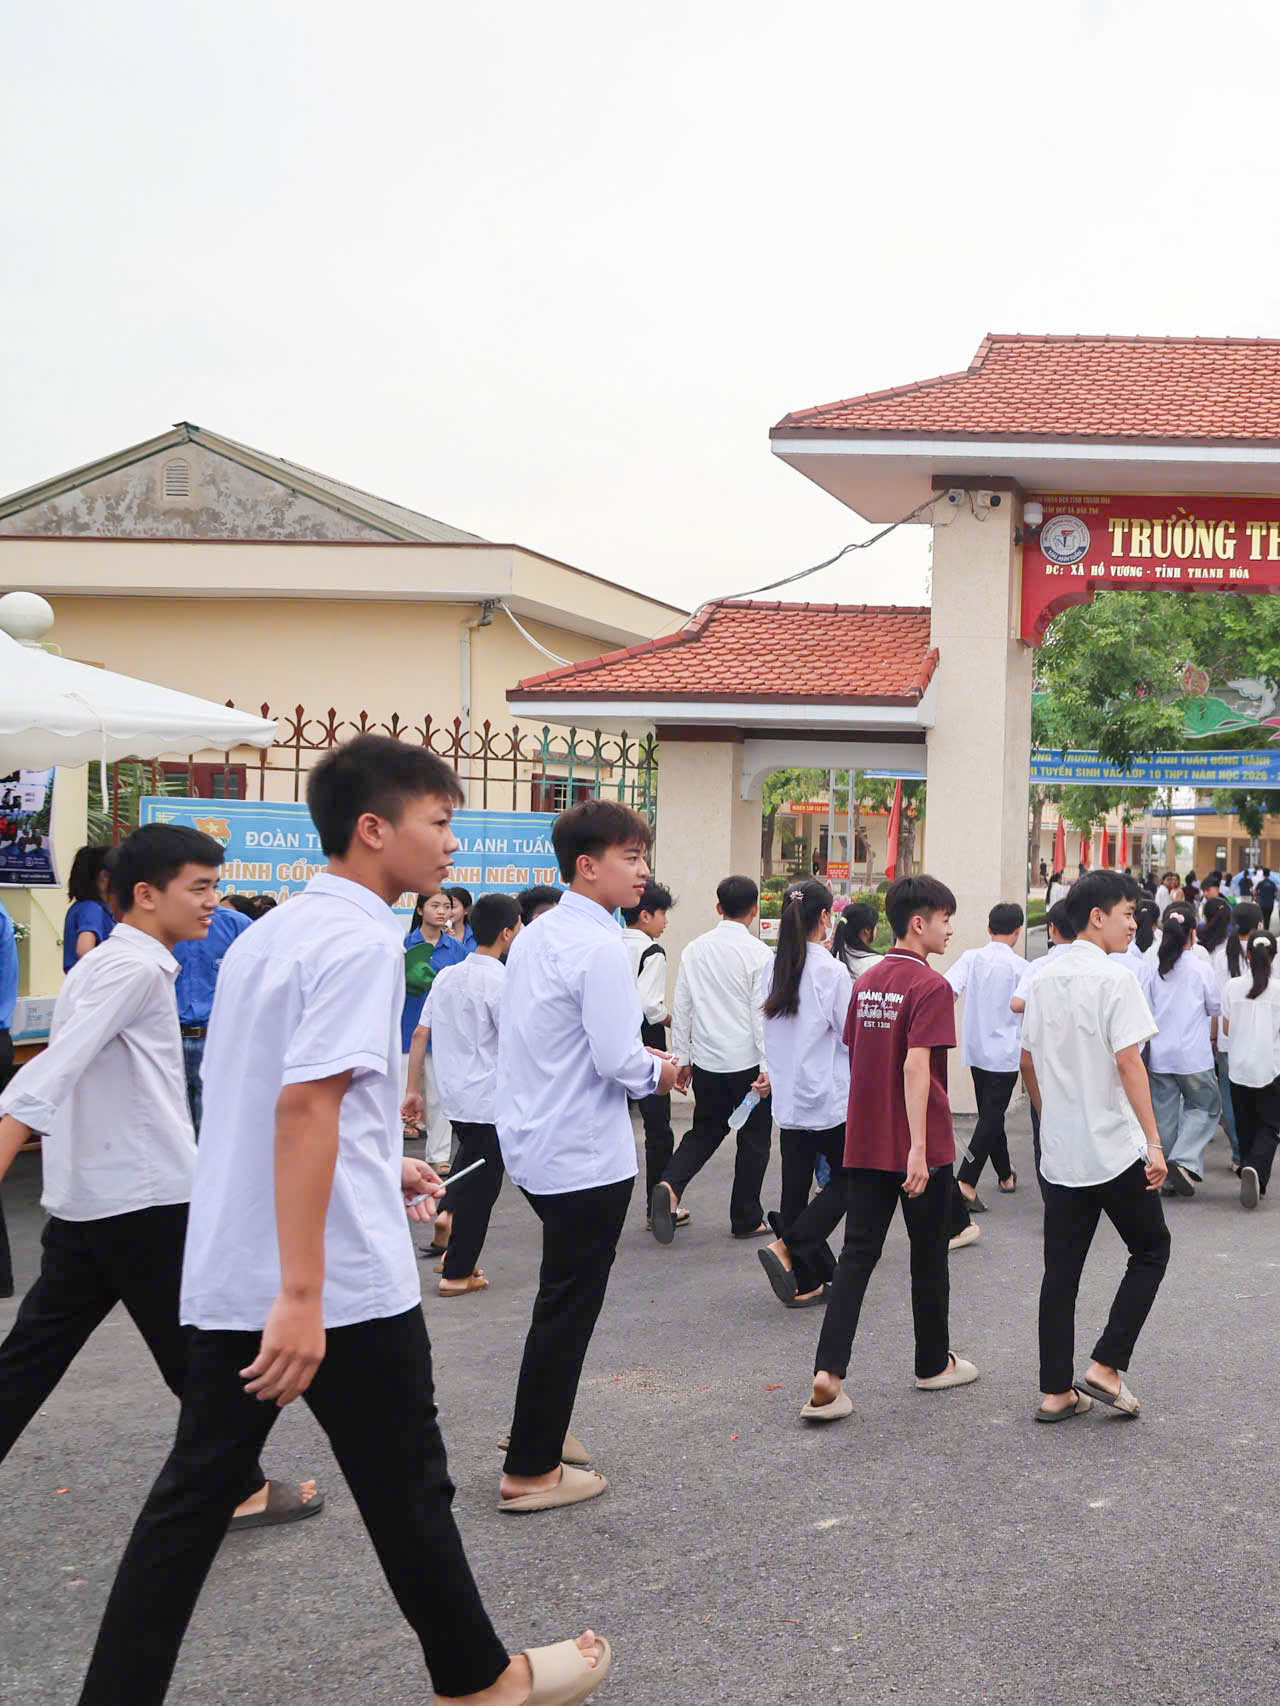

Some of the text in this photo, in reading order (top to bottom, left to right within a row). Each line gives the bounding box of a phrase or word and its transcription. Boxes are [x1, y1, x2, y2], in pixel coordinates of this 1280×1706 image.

[1108, 506, 1237, 560] TRƯỜNG
[1110, 565, 1143, 577] VƯƠNG
[1155, 564, 1181, 578] TỈNH
[1188, 567, 1224, 579] THANH
[1229, 566, 1250, 579] HÓA
[245, 828, 299, 848] ĐOÀN
[457, 838, 468, 852] AI
[473, 838, 507, 853] ANH
[512, 834, 555, 853] TUẤN
[219, 858, 272, 881] HÌNH
[486, 864, 529, 885] NIÊN
